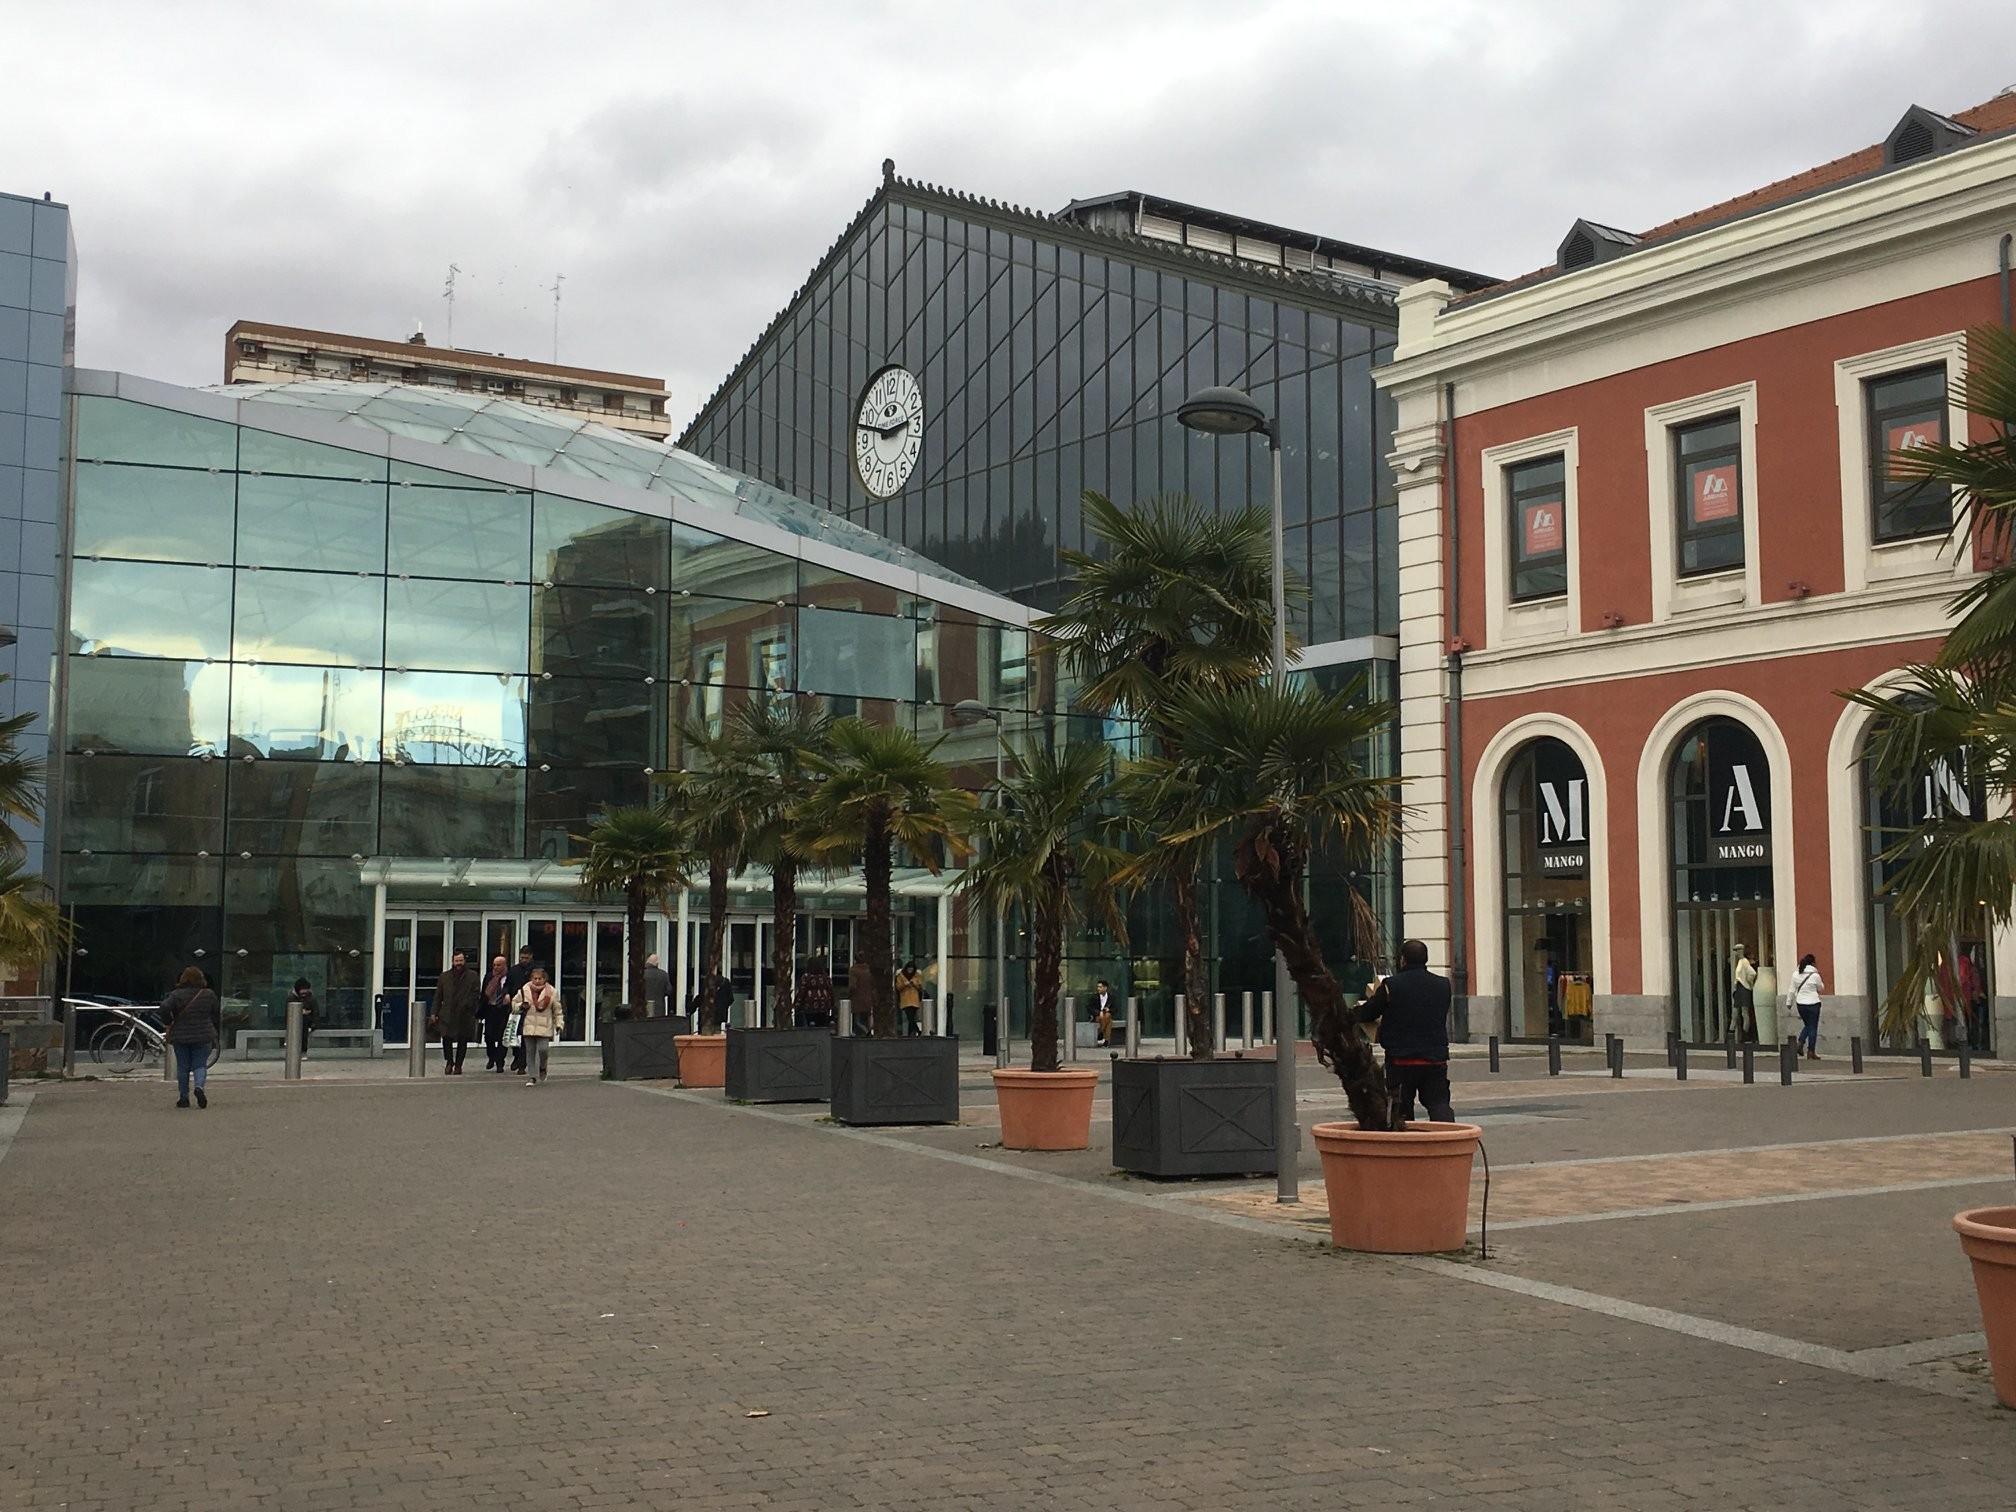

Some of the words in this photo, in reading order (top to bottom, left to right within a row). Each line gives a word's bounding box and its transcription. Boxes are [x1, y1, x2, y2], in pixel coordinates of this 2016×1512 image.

[886, 377, 896, 396] 12
[875, 388, 882, 407] 11
[910, 392, 918, 411] 2
[865, 408, 875, 425] 10
[913, 415, 921, 434] 3
[861, 433, 869, 450] 9
[909, 440, 917, 459] 4
[864, 455, 872, 473] 8
[899, 461, 907, 479] 5
[875, 469, 883, 487] 7
[886, 471, 894, 489] 6
[1718, 764, 1763, 832] A
[1539, 778, 1587, 844] M
[1718, 844, 1764, 860] MANGO
[1544, 855, 1584, 869] MANGO
